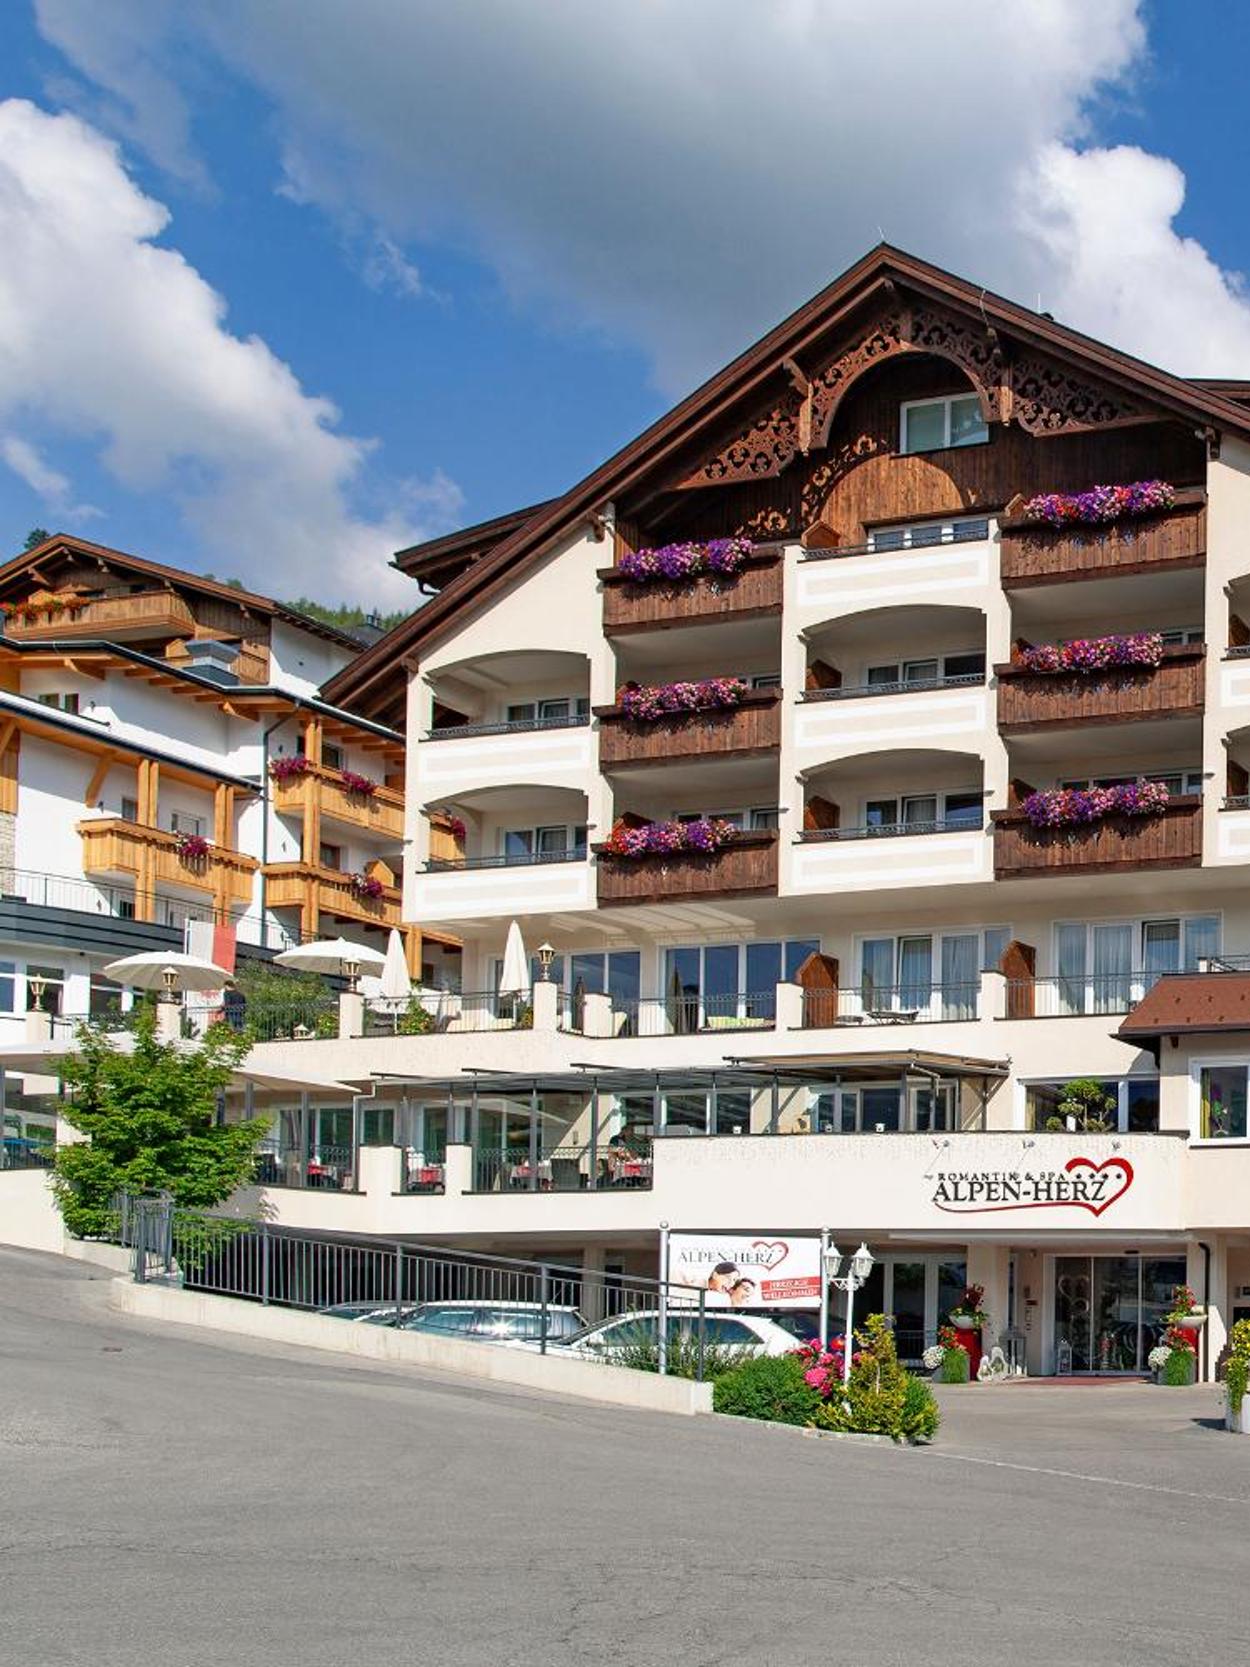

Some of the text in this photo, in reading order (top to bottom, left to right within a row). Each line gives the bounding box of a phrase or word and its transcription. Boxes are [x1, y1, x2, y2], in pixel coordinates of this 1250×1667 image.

[938, 1172, 1066, 1182] ROMANTIK & SPA
[933, 1180, 1106, 1202] ALPEN-HERZ
